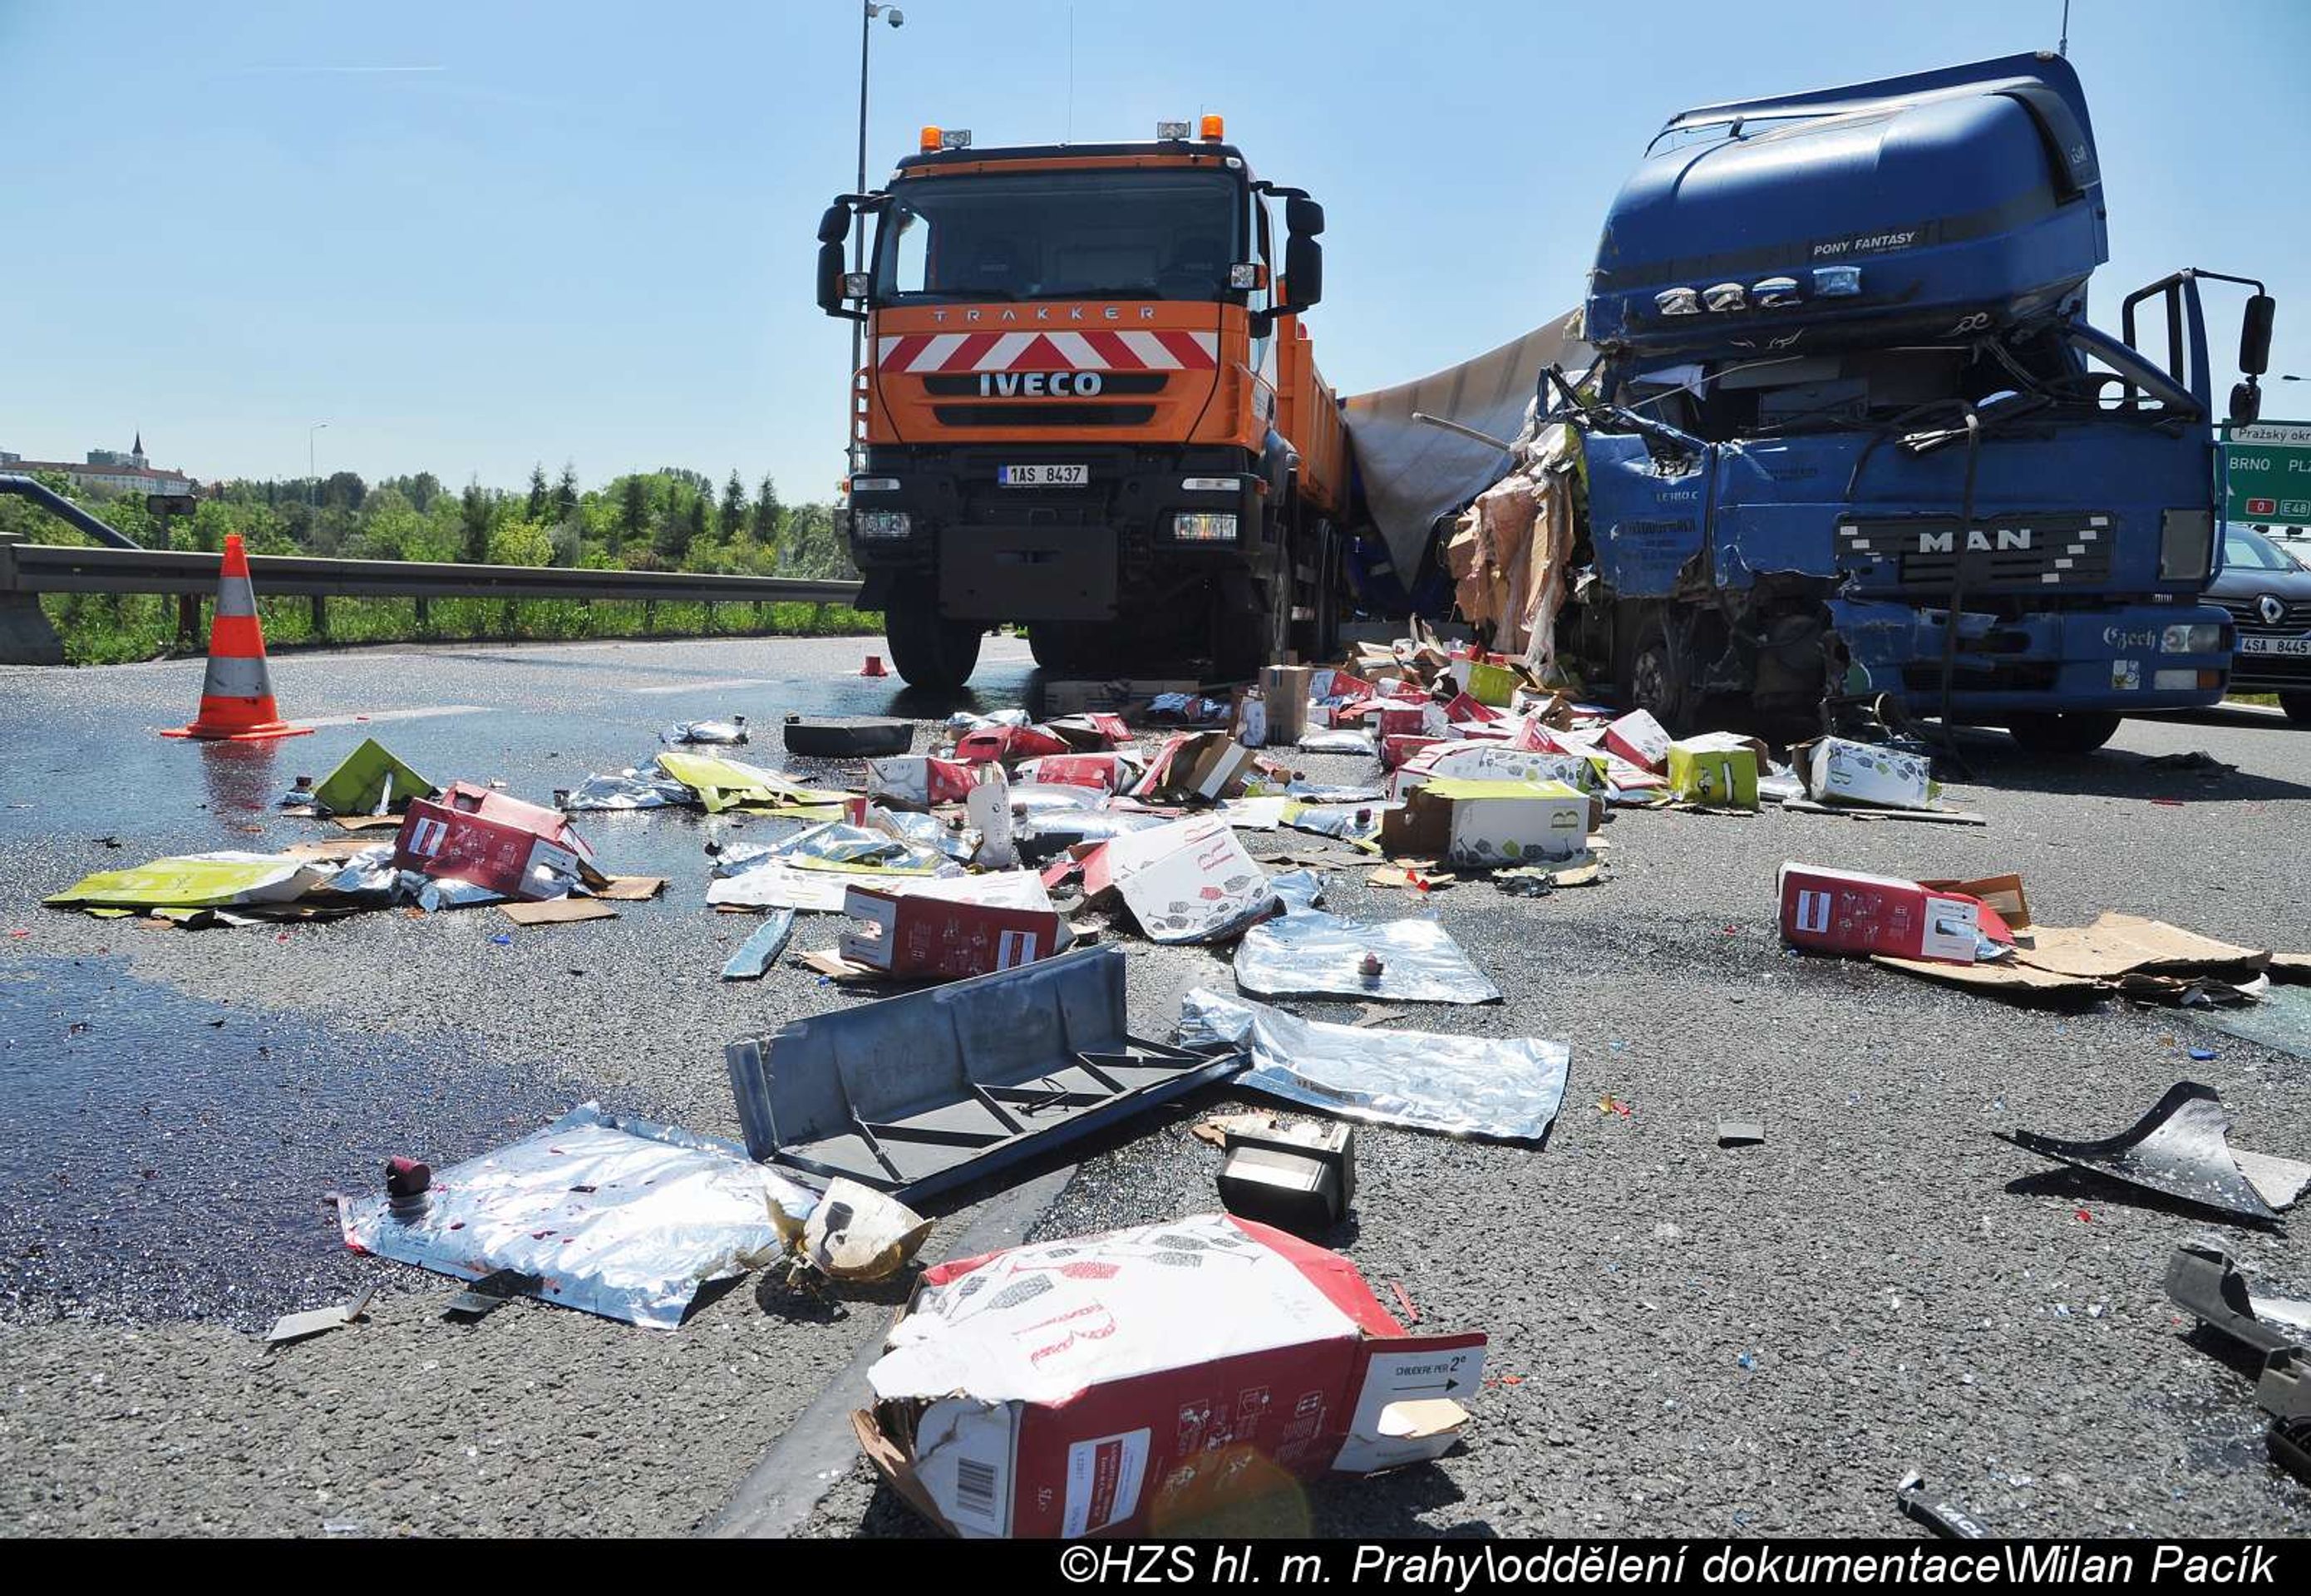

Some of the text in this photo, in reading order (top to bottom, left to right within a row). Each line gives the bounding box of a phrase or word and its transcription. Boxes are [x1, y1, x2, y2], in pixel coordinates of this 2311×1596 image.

[1814, 240, 1850, 255] PONY
[1855, 231, 1915, 249] FANTASY
[934, 308, 1155, 322] TRAKKER
[979, 372, 1102, 397] IVECO
[2239, 427, 2287, 442] Pražský
[2230, 457, 2270, 470] BRNO
[1011, 467, 1082, 482] 1AS 8437
[2284, 503, 2307, 514] E48
[1919, 529, 2031, 553] MAN
[2103, 627, 2156, 649] Czech
[2244, 641, 2309, 653] 4SA 8445
